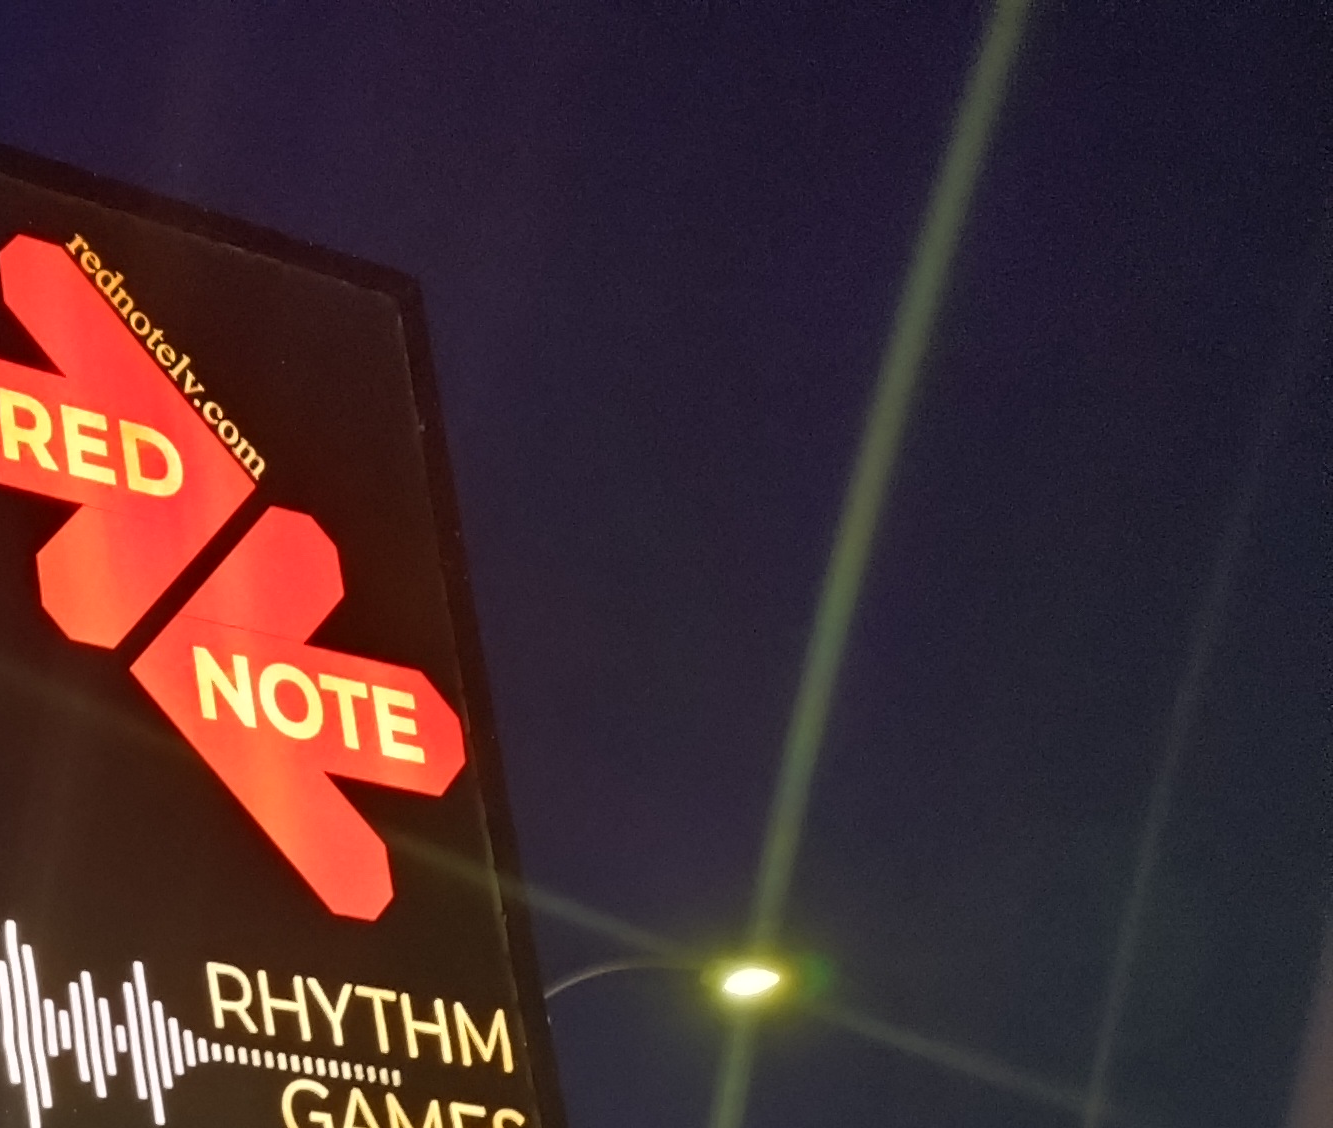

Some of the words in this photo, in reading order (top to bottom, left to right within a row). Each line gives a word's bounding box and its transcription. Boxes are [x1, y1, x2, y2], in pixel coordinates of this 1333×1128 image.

[66, 233, 266, 482] rednotelv.com
[192, 645, 426, 764] NOTE
[206, 961, 514, 1074] RHYTHM
